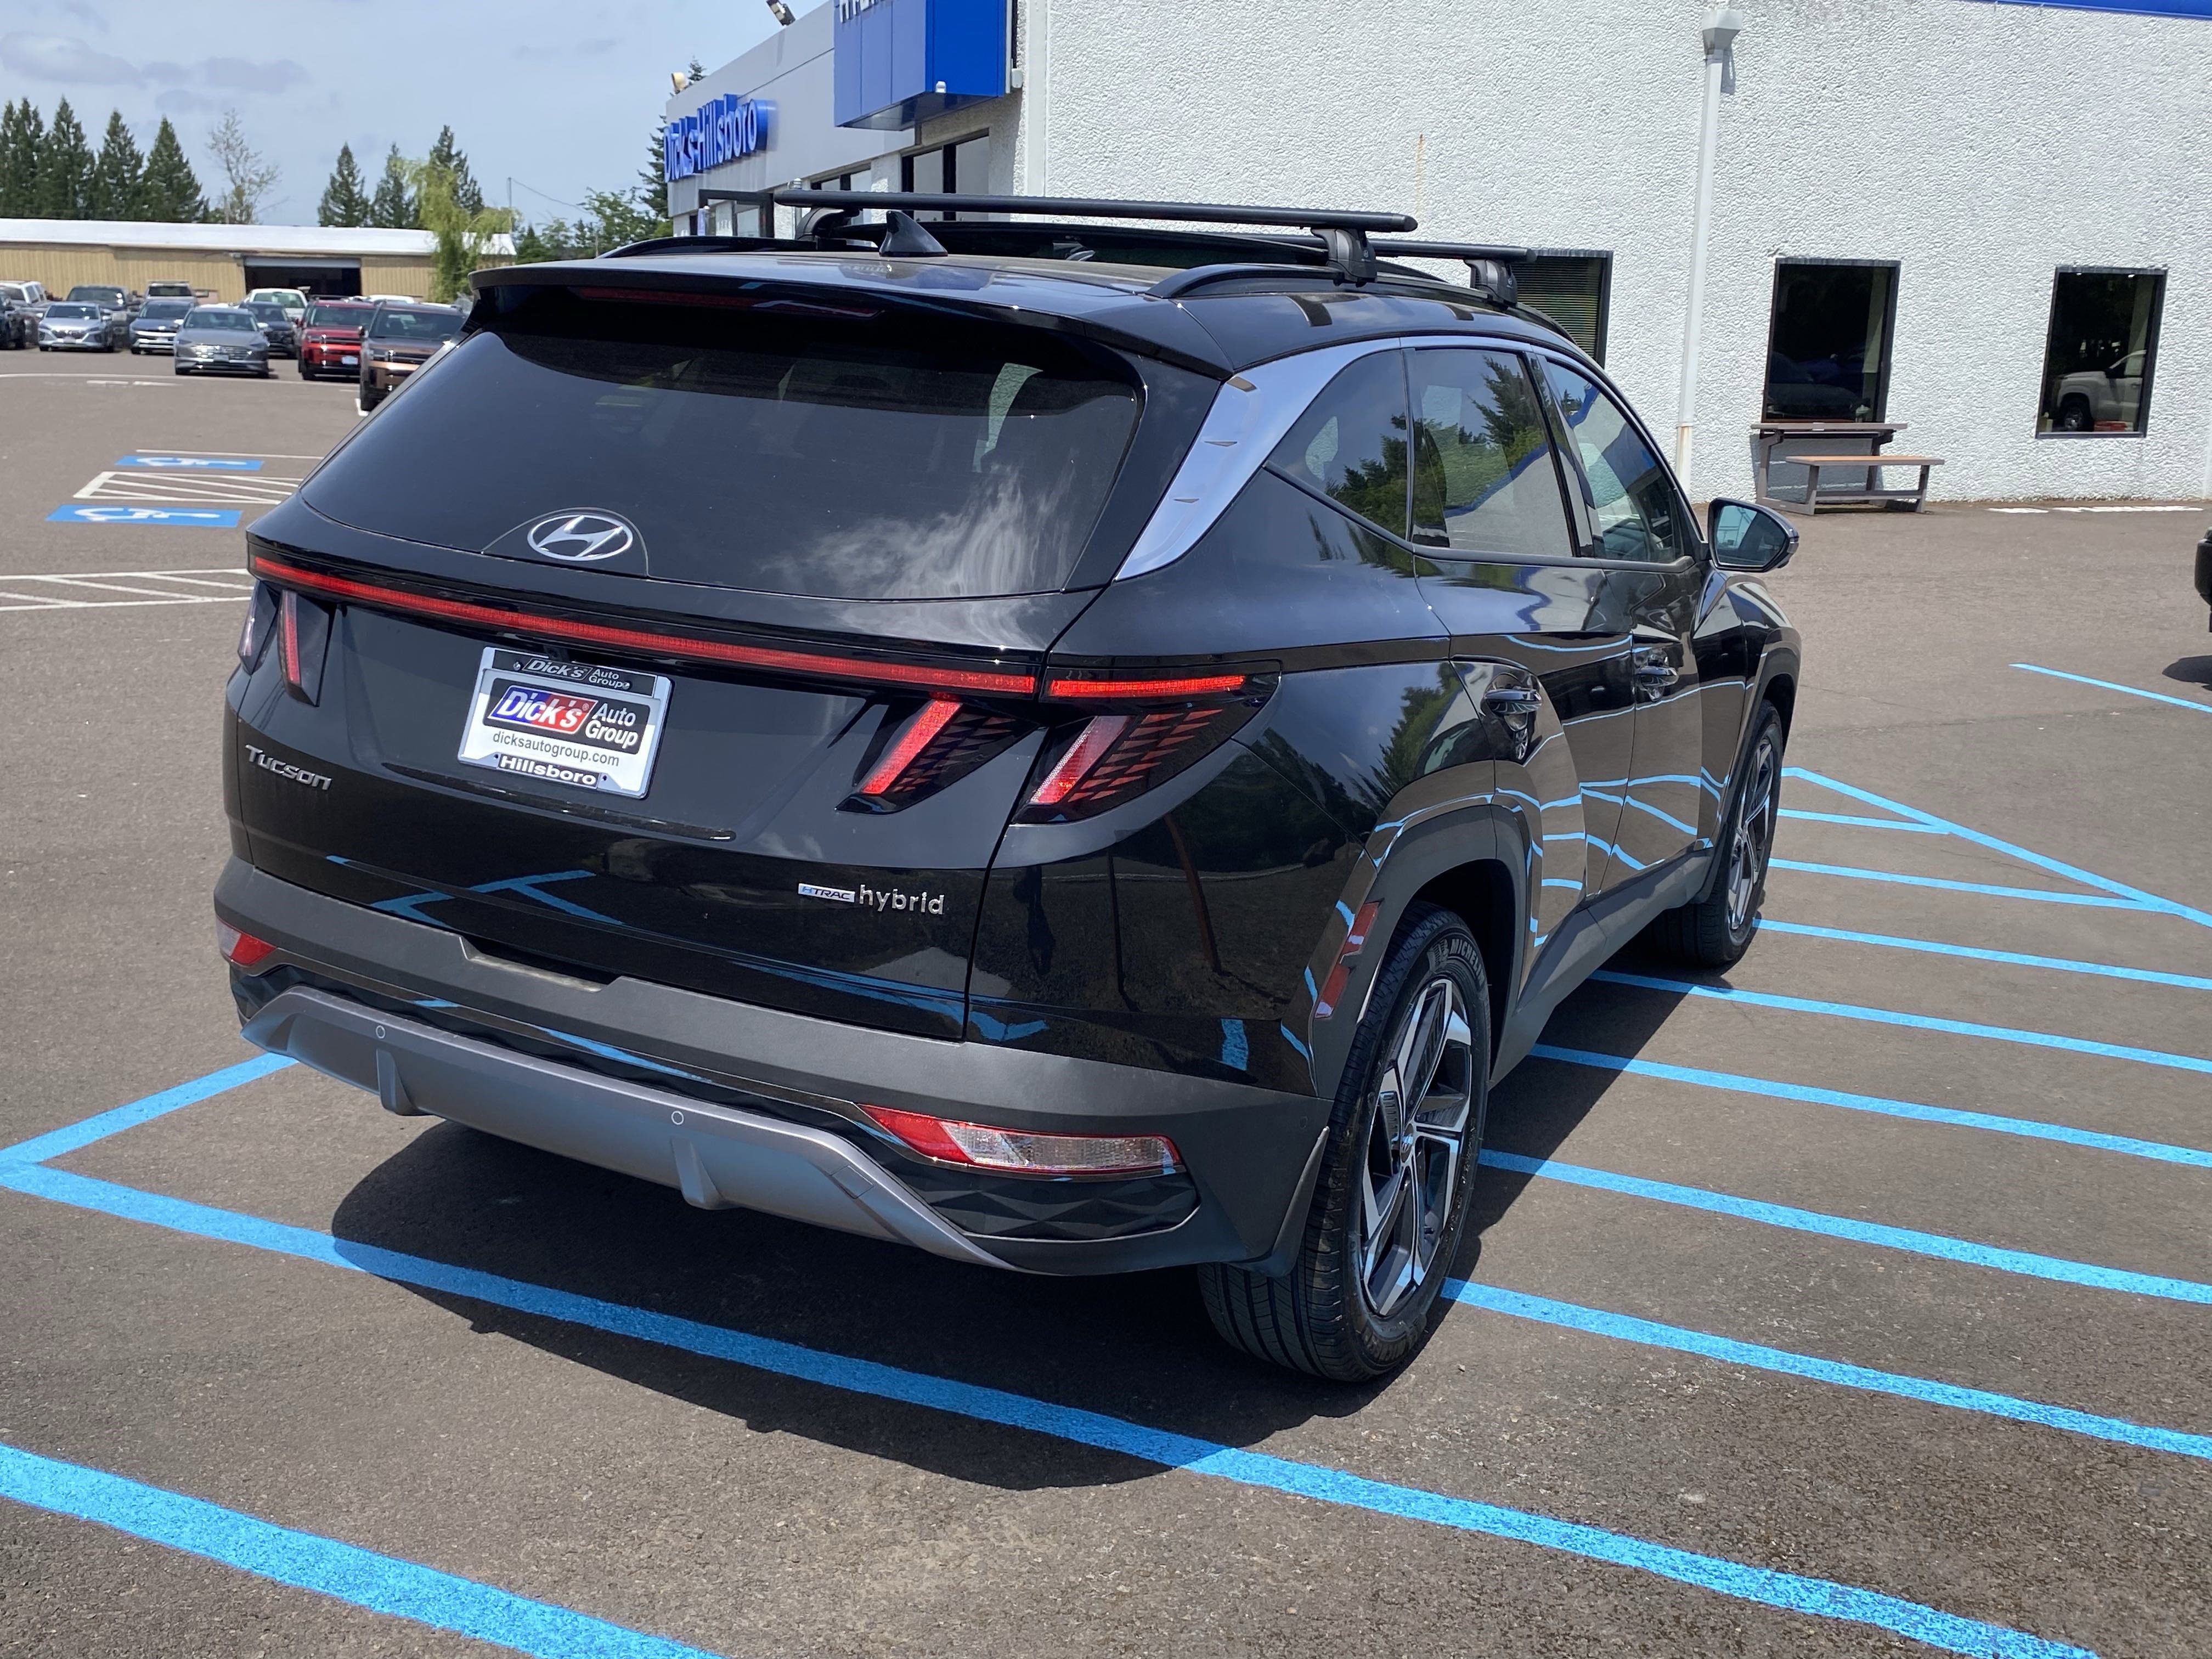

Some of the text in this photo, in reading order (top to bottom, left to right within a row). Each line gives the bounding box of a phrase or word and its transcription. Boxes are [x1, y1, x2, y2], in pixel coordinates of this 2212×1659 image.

[697, 94, 758, 171] Hillsboro
[527, 660, 584, 678] Dick's
[589, 676, 623, 689] Group
[592, 669, 619, 679] Auto
[591, 703, 636, 726] Auto
[493, 731, 619, 766] dicksautogroup.com
[585, 720, 638, 748] Group
[500, 755, 597, 786] Hillsboro
[859, 884, 944, 915] hybrid
[1449, 939, 1485, 987] MICHELIN
